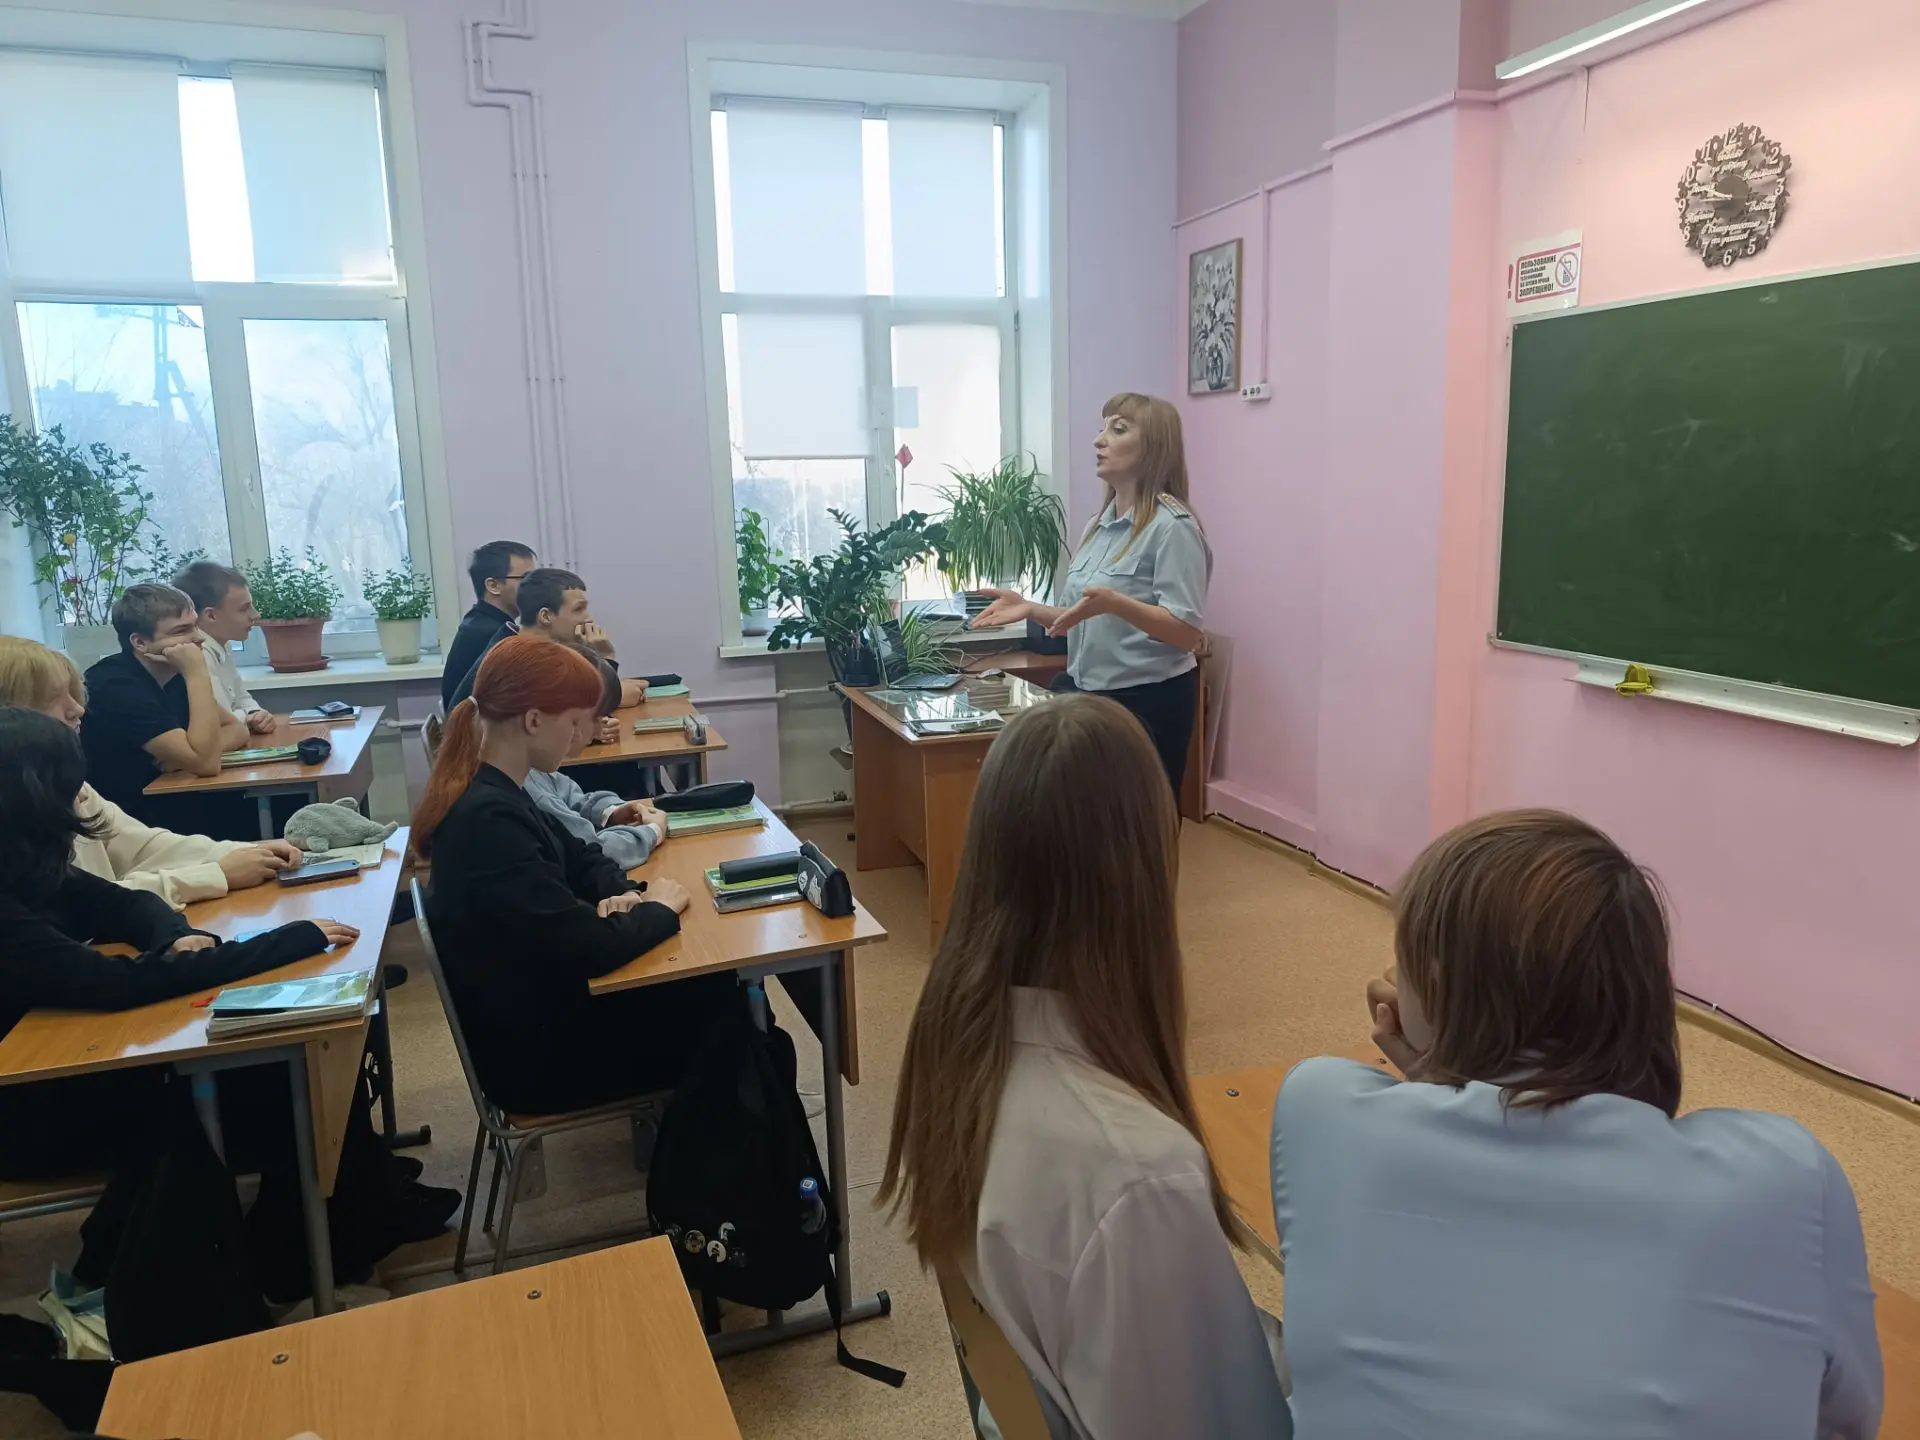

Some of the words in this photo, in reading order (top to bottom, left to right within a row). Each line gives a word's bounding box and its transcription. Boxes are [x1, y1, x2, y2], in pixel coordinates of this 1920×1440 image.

[1723, 127, 1738, 147] 12
[1749, 127, 1758, 144] 1
[1700, 141, 1713, 161] 11
[1769, 147, 1780, 165] 2
[1681, 165, 1696, 184] 10
[1774, 178, 1785, 196] 3
[1677, 199, 1687, 215] 9
[1767, 210, 1777, 228] 4
[1682, 226, 1691, 242] 8
[1701, 241, 1710, 258] 7
[1747, 237, 1757, 255] 5
[1521, 255, 1556, 269] ПОЛЬЗОВАНИЕ
[1723, 248, 1733, 266] 6
[1520, 283, 1553, 296] ЗАПРЕЩЕНО!
